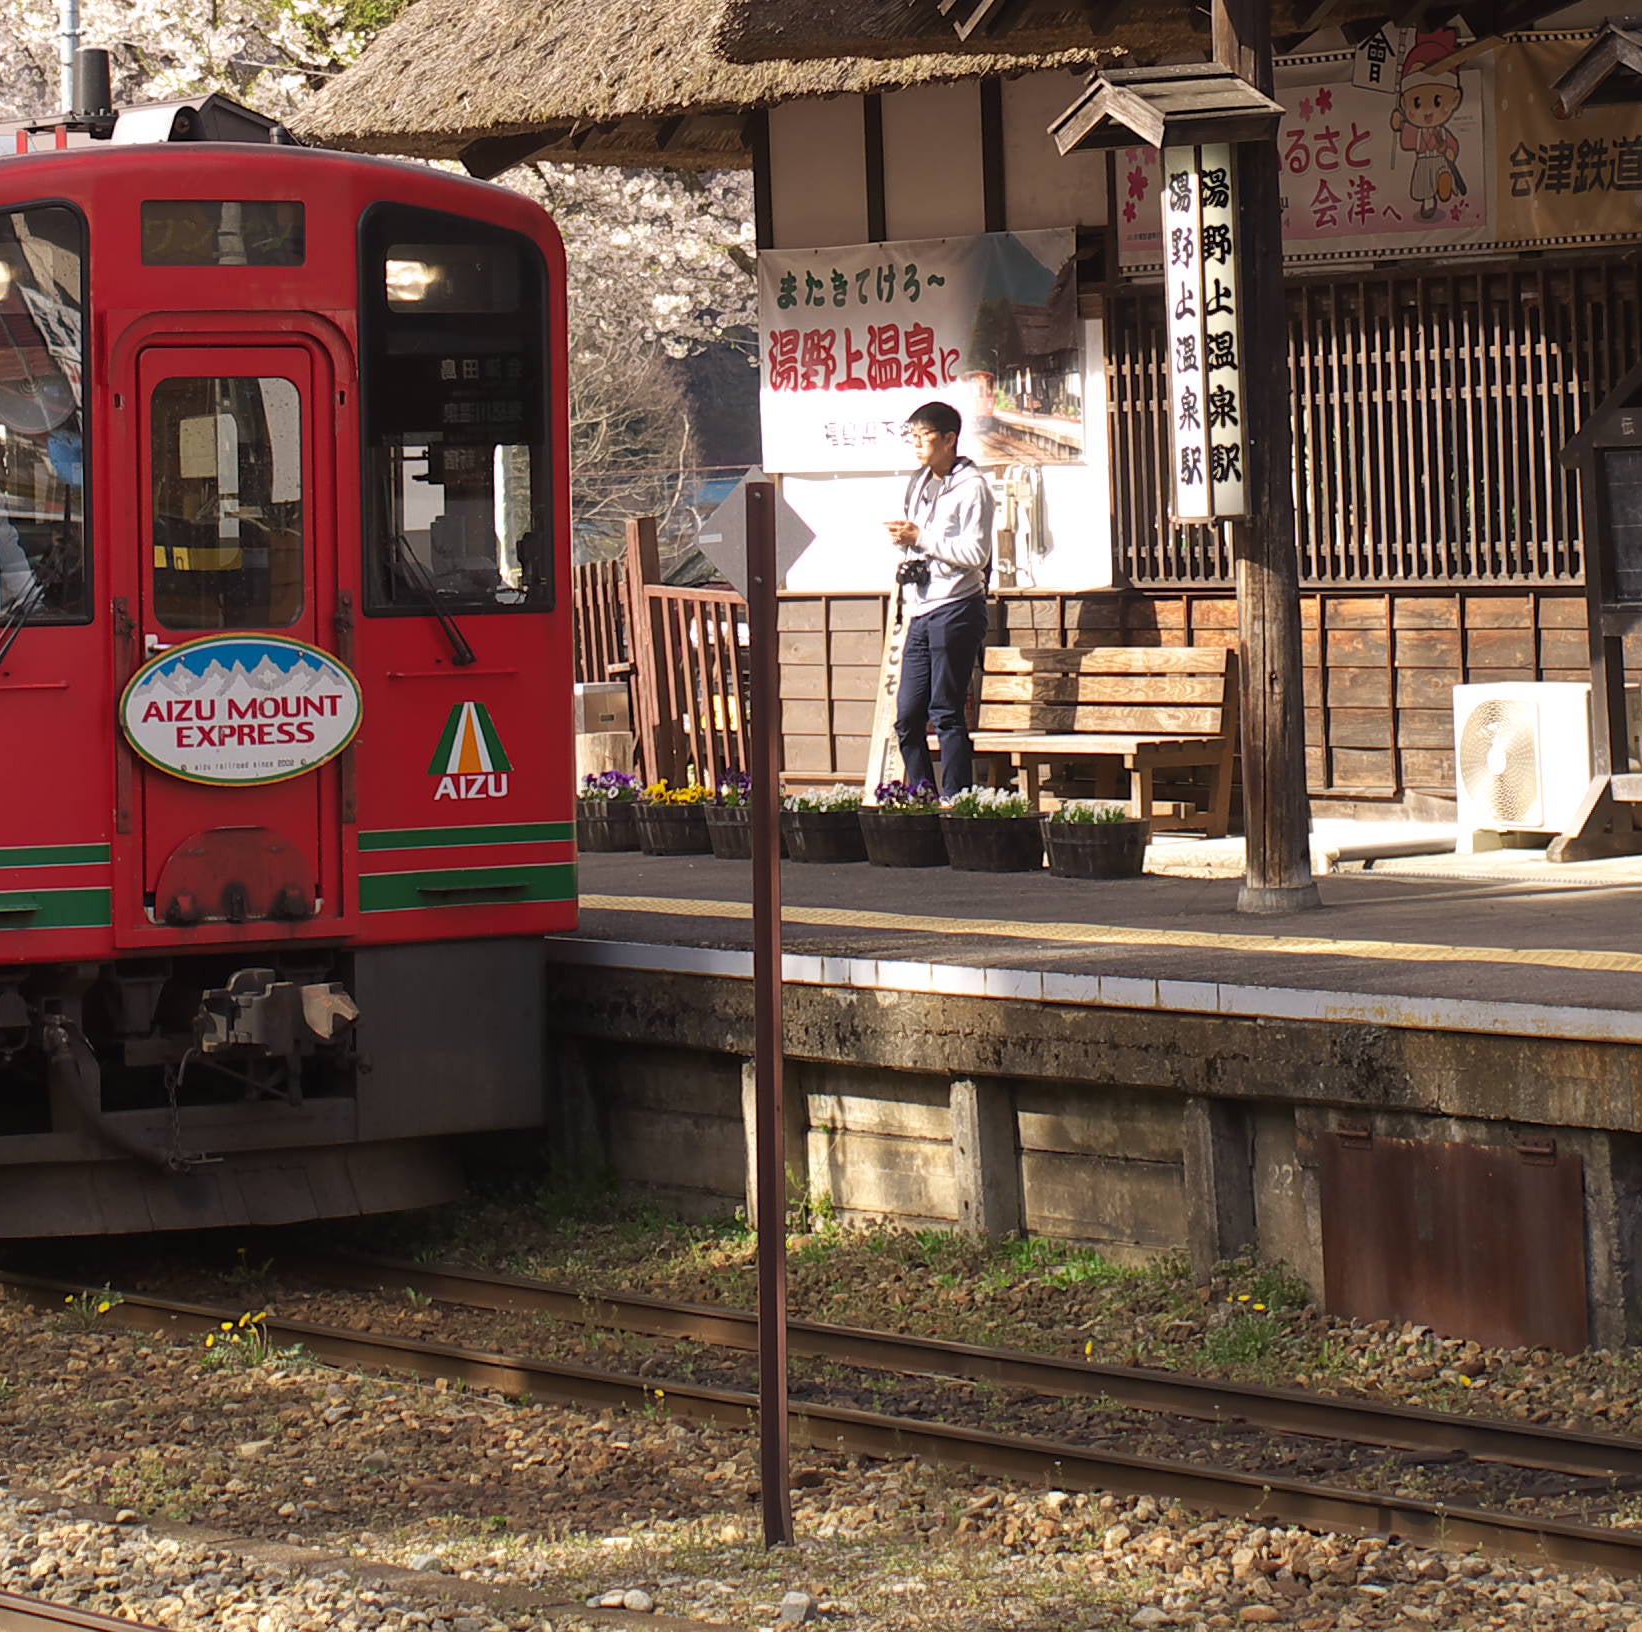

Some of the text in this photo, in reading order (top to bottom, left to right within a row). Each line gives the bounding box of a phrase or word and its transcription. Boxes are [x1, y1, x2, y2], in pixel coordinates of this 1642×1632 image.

[1276, 122, 1372, 178] るさと
[1309, 175, 1403, 228] 会津へ
[1169, 172, 1204, 486] 湯野上温泉駅
[1201, 167, 1243, 484] 湯野上温泉駅
[768, 322, 961, 393] 湯野上温泉に
[141, 693, 343, 724] AIZU MOUNT
[176, 722, 315, 749] EXPRESS
[252, 760, 274, 768] since
[433, 773, 509, 801] AIZU
